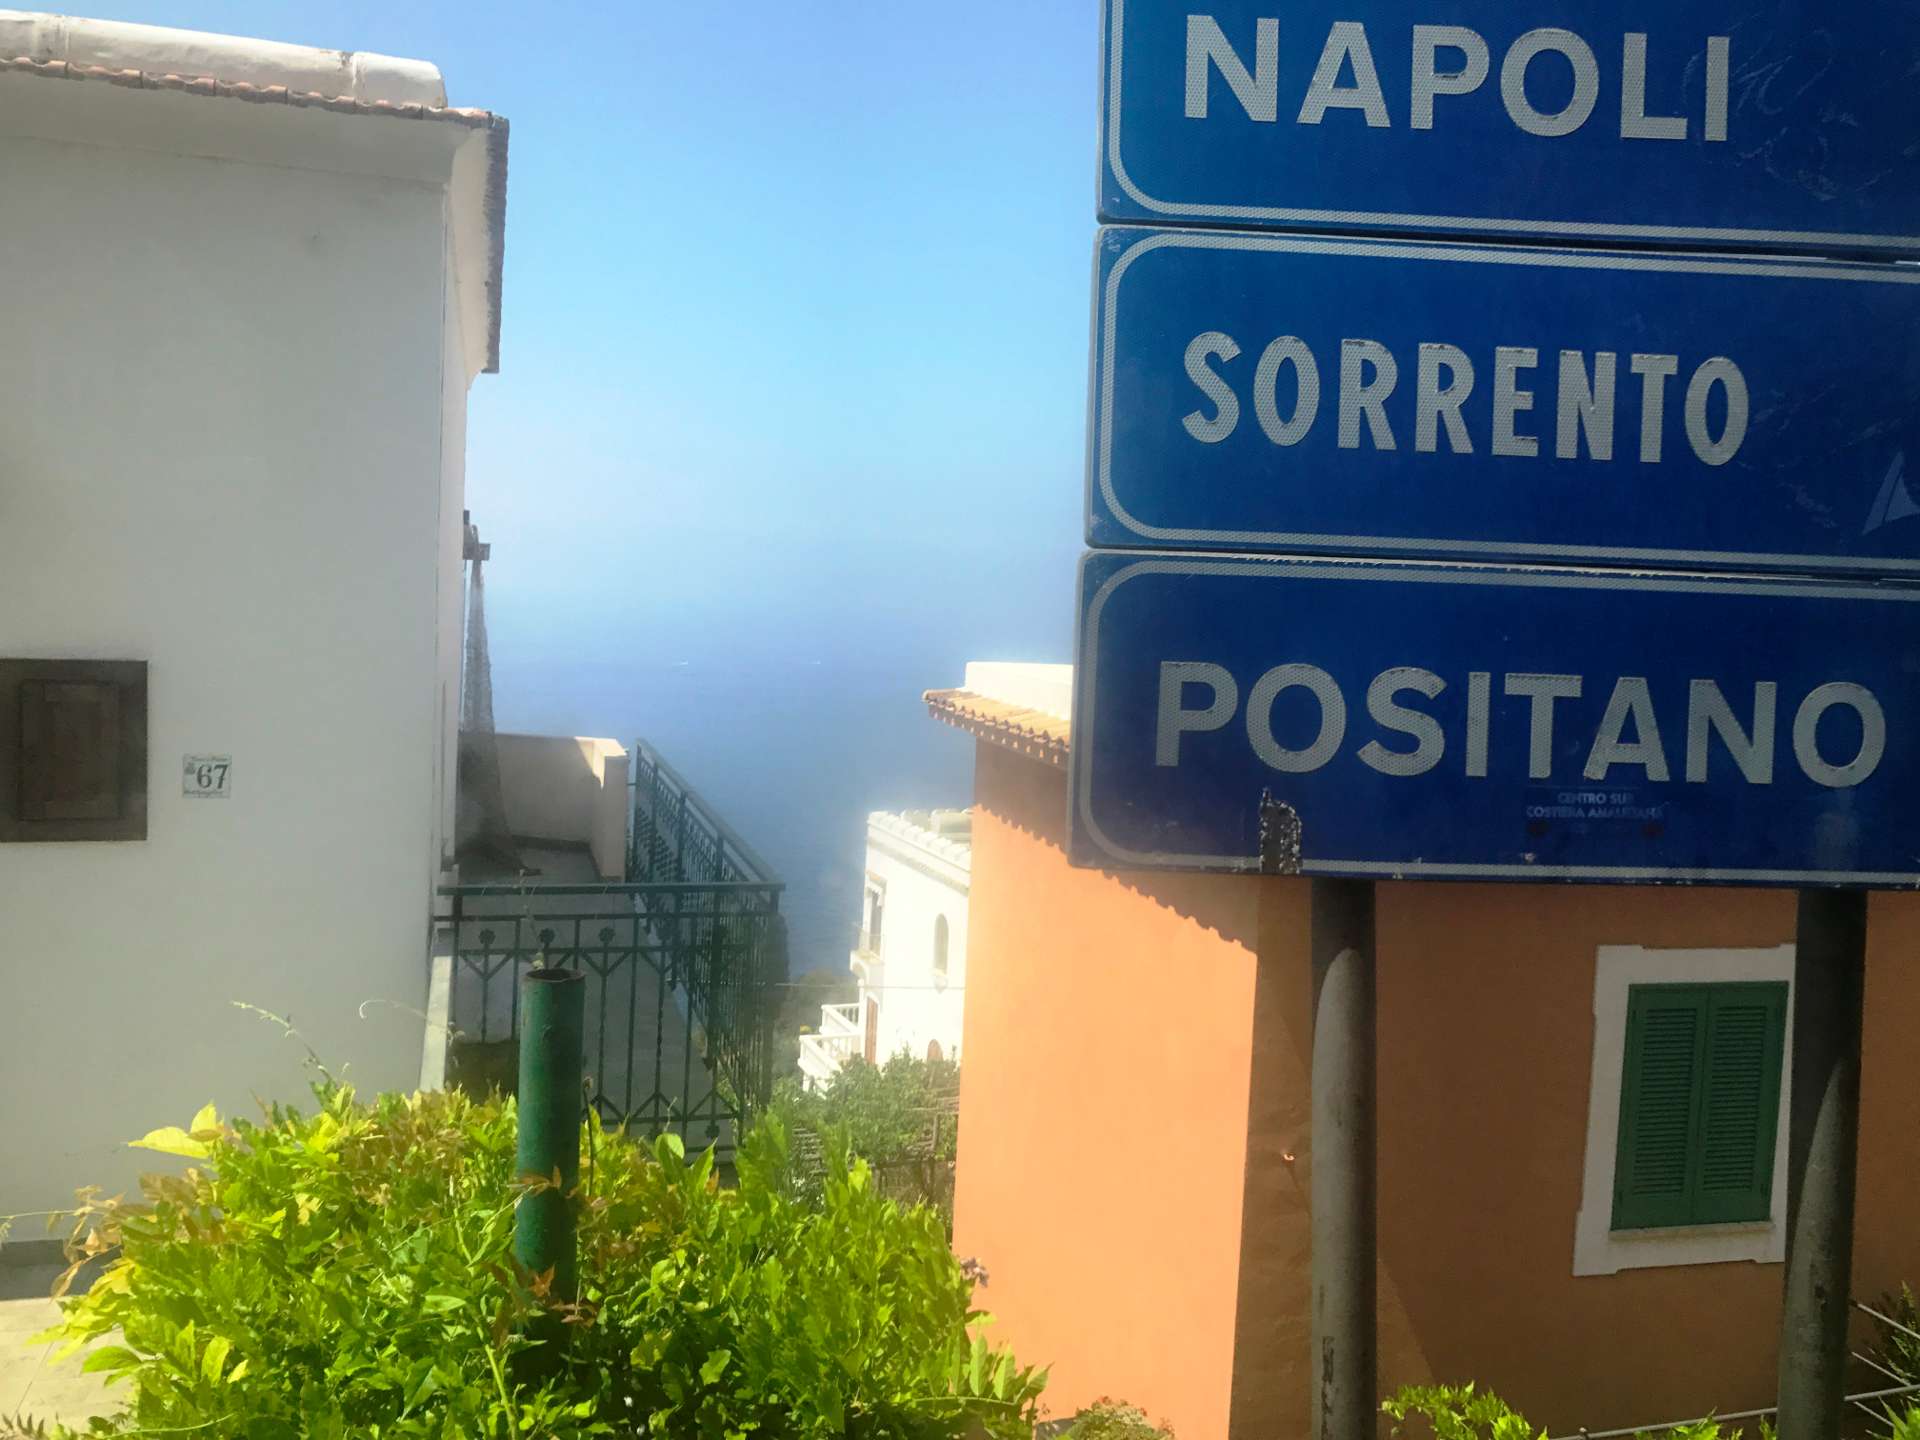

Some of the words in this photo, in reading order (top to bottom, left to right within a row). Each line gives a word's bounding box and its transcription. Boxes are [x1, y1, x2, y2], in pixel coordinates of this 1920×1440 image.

[1184, 14, 1730, 142] NAPOLI
[1182, 331, 1749, 466] SORRENTO
[197, 764, 228, 789] 67
[1156, 660, 1886, 787] POSITANO
